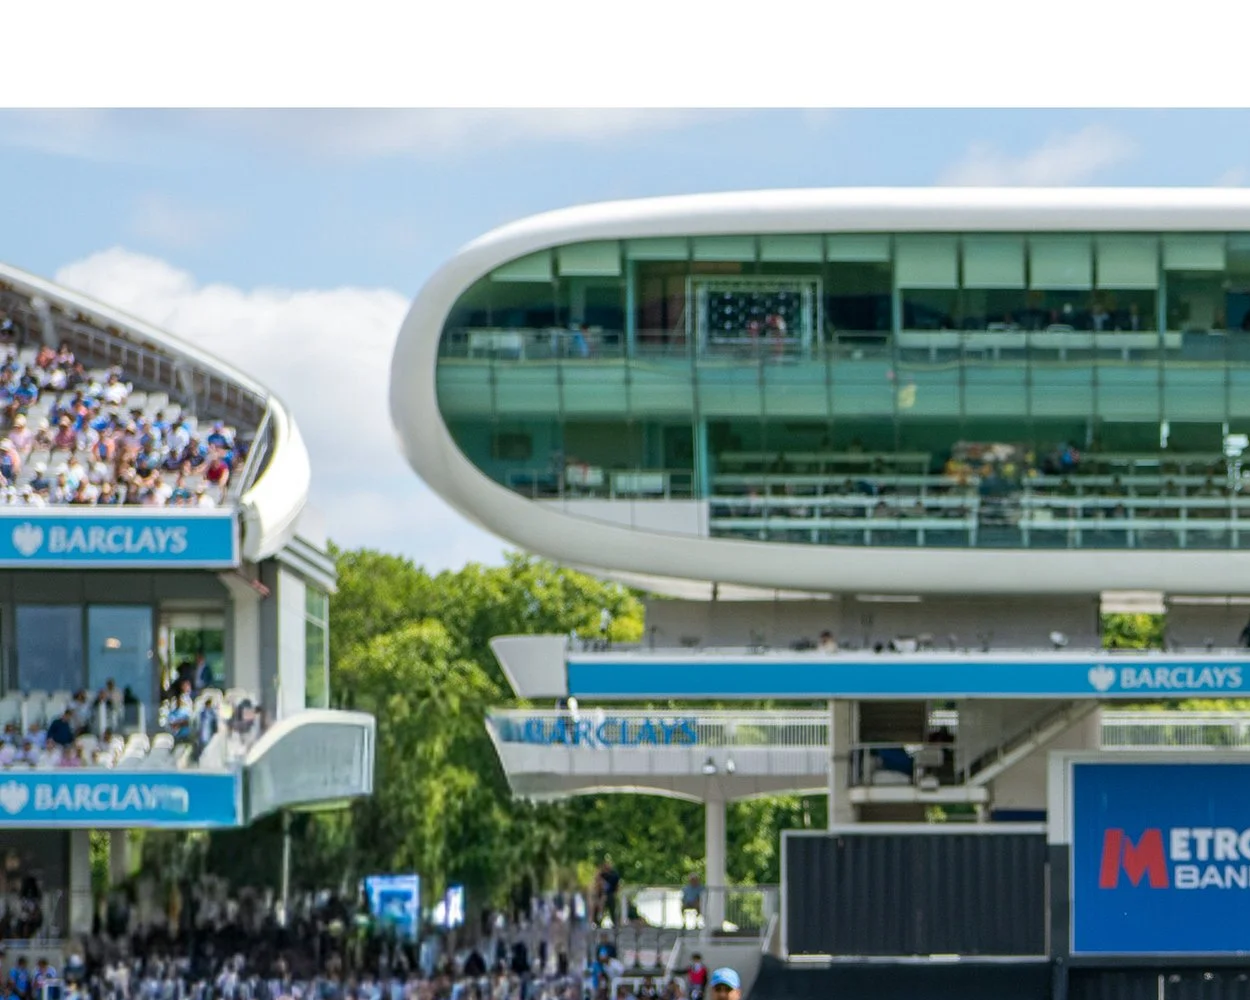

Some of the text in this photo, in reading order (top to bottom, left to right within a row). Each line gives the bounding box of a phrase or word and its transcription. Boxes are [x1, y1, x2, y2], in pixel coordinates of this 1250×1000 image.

[48, 525, 188, 554] BARCLAYS
[1120, 666, 1243, 689] BARCLAYS
[34, 783, 184, 812] BARCLAY
